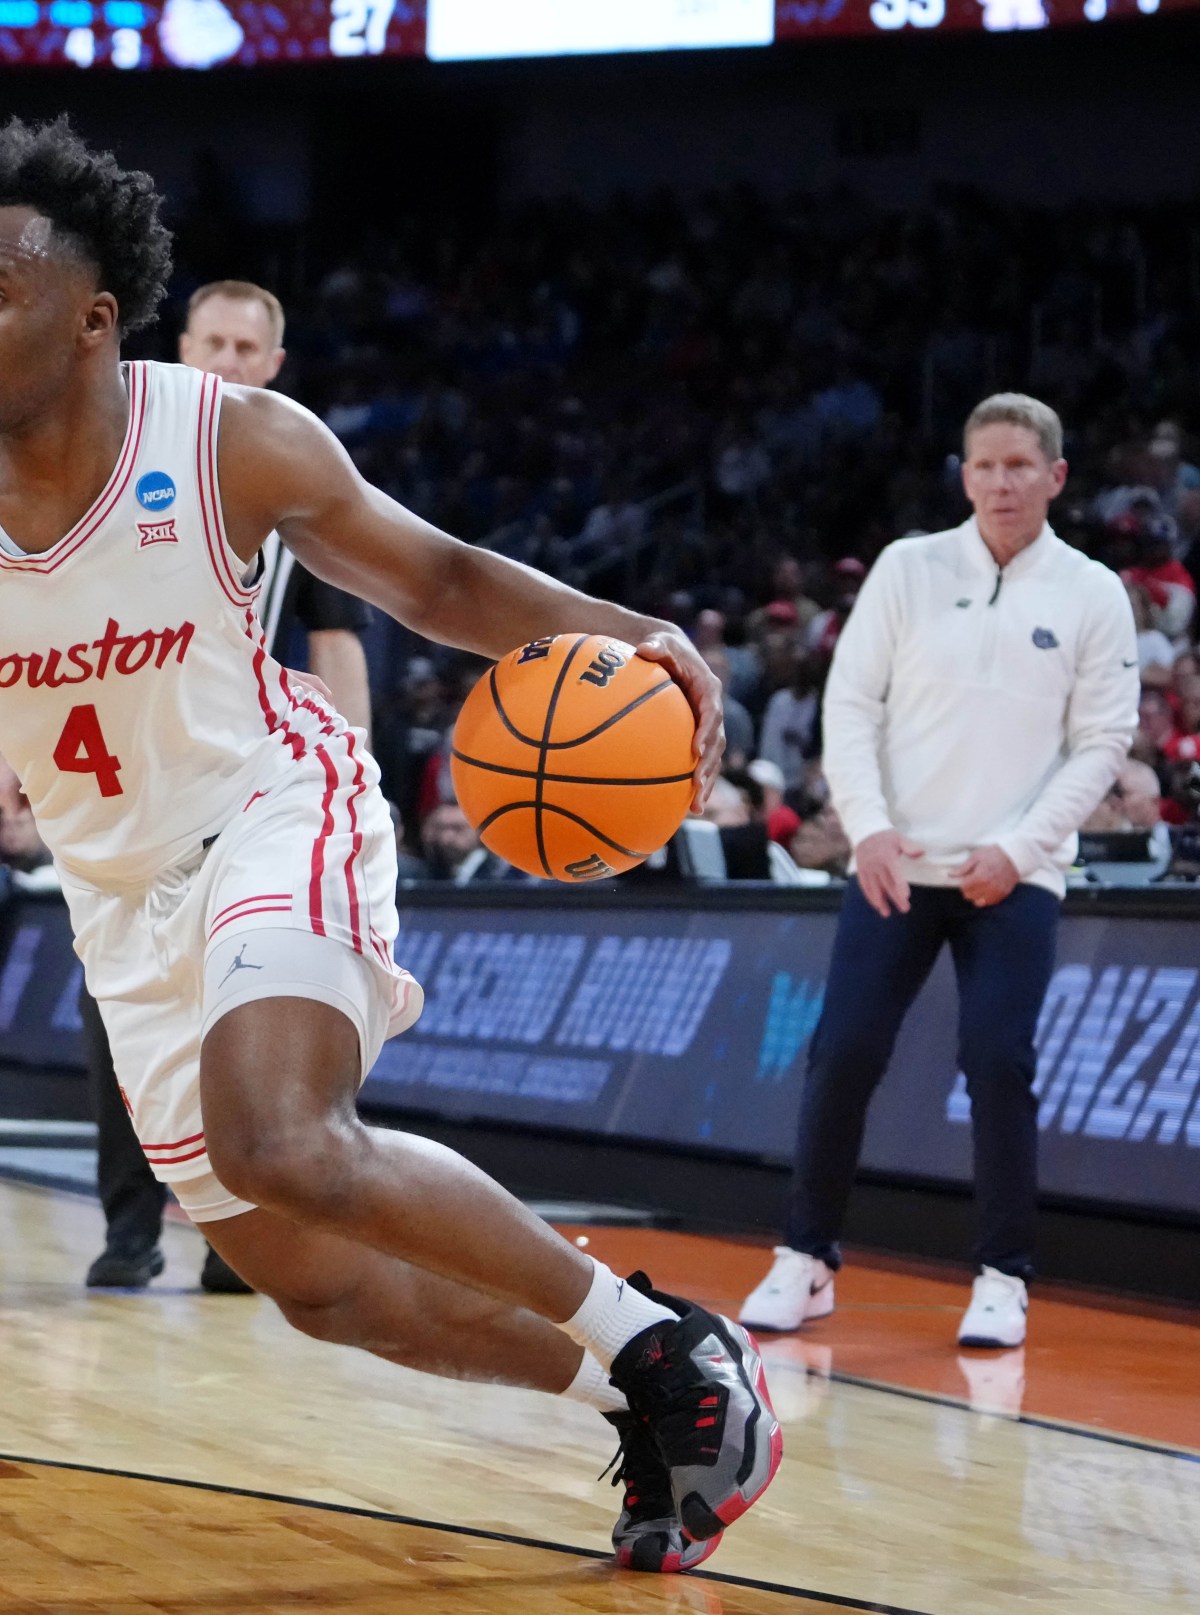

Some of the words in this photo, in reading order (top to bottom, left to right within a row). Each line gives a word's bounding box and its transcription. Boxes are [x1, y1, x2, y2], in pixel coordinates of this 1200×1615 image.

[330, 0, 393, 56] 27
[143, 487, 175, 503] NCAA
[141, 524, 175, 544] XII
[52, 703, 124, 798] 4
